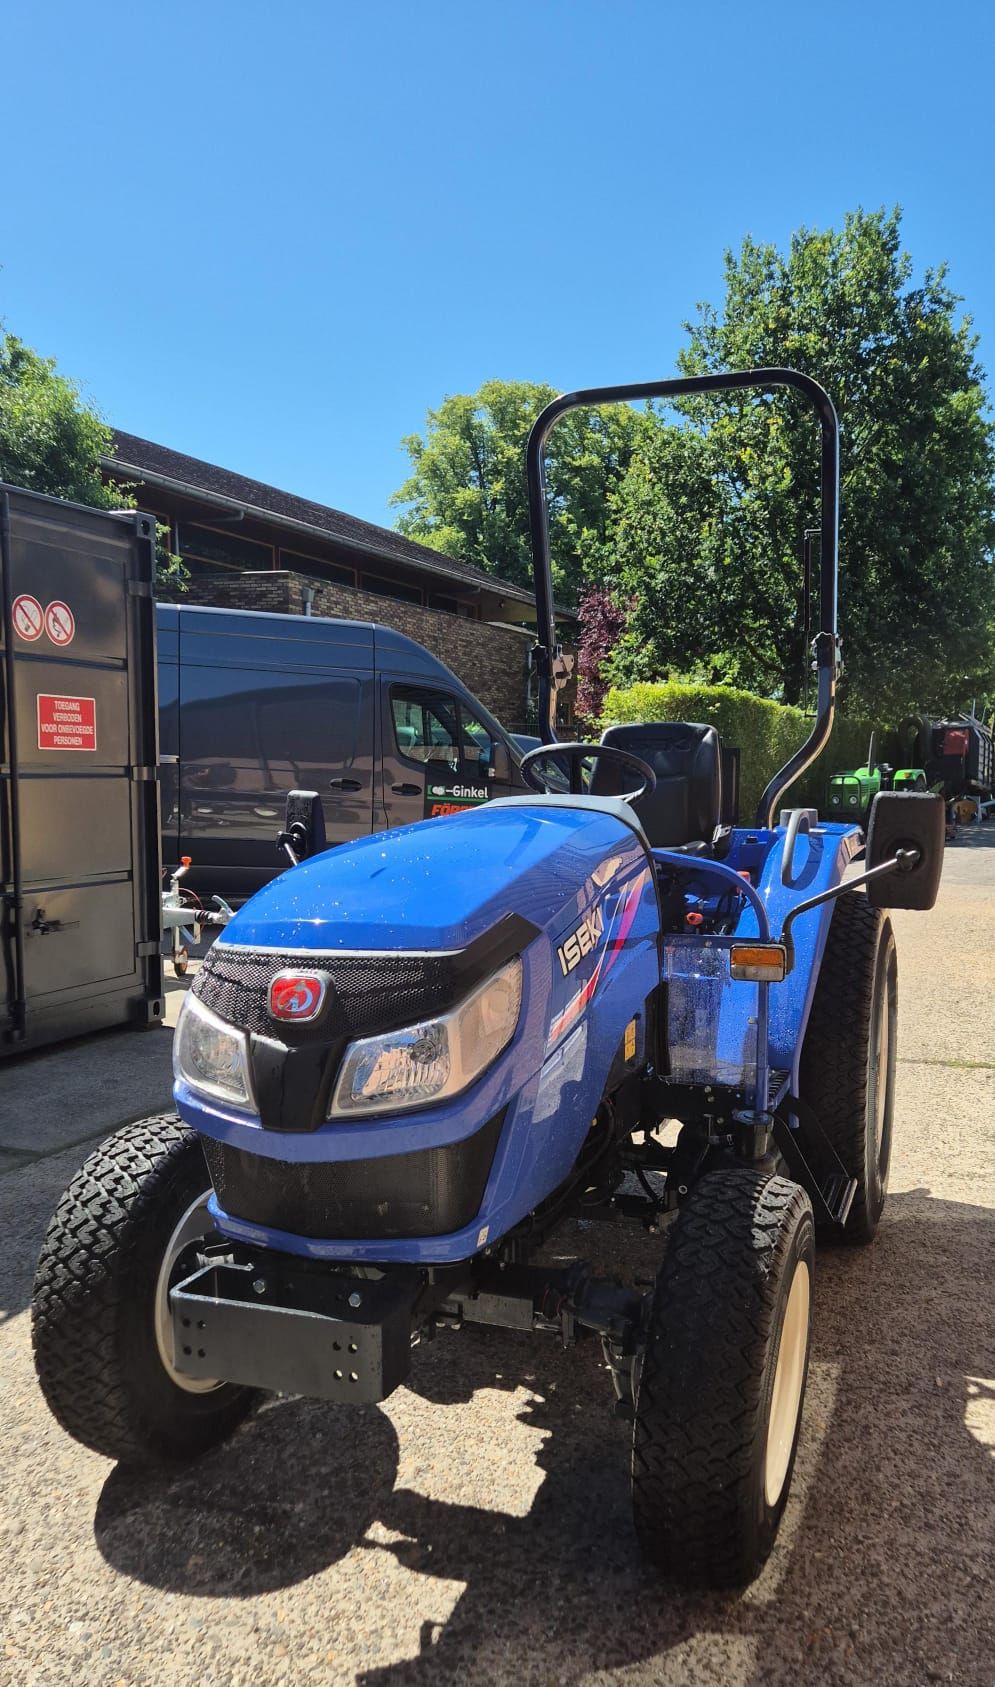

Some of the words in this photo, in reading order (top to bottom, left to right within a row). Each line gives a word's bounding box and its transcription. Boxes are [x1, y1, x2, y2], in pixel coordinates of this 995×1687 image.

[54, 700, 80, 711] TOEGANG
[53, 712, 82, 722] VERBODEN
[41, 723, 57, 733] VOOR
[54, 735, 82, 745] PERSONEN
[557, 906, 604, 977] ISEKI
